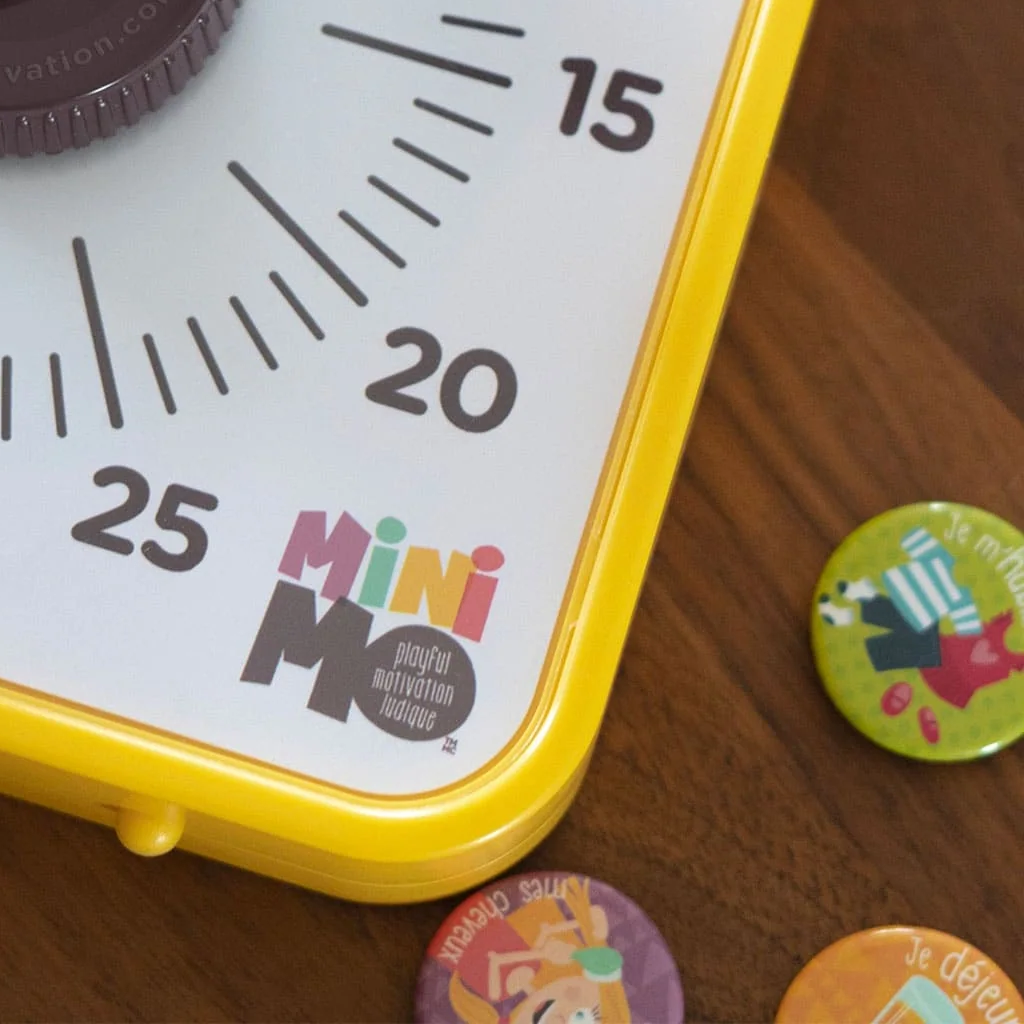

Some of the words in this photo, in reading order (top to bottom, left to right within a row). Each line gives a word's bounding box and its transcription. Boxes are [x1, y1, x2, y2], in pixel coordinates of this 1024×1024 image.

[558, 56, 665, 154] 15
[364, 325, 519, 435] 20
[69, 464, 220, 574] 25
[944, 511, 972, 544] Je
[371, 667, 454, 707] motivation
[393, 641, 451, 676] playful
[379, 693, 437, 732] ludique
[518, 877, 568, 904] mes
[436, 890, 511, 964] cheveux
[905, 936, 932, 970] Je
[939, 945, 1024, 1024] déjeu
